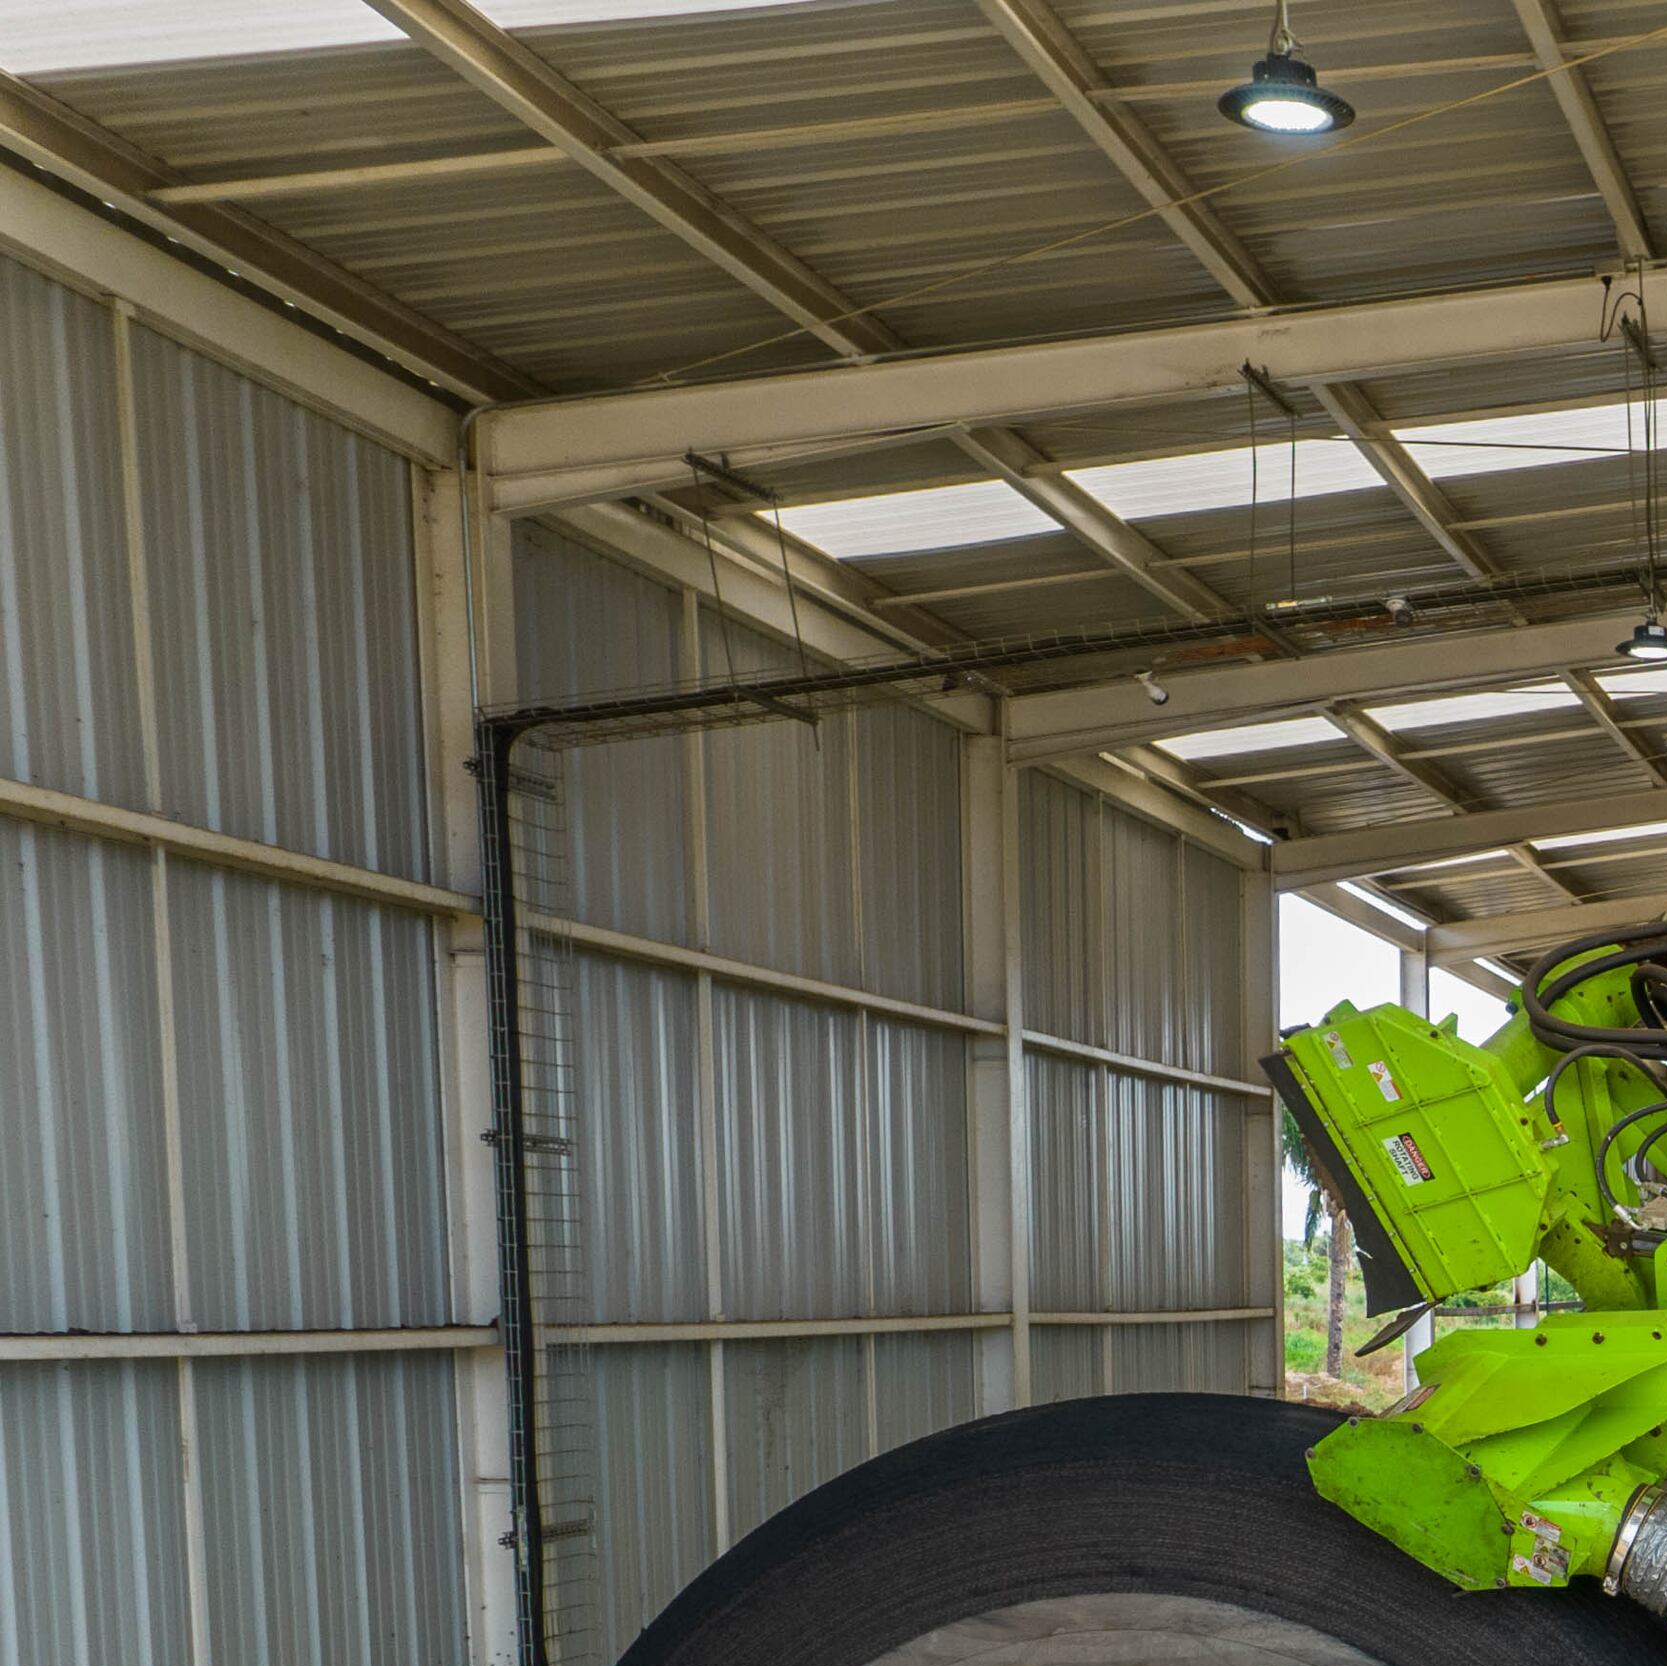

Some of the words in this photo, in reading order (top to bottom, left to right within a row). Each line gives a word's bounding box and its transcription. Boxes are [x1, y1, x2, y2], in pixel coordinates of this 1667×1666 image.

[1389, 1148, 1408, 1175] SHAFT
[1392, 1140, 1420, 1180] ROTATING
[1404, 1139, 1429, 1174] DANGER
